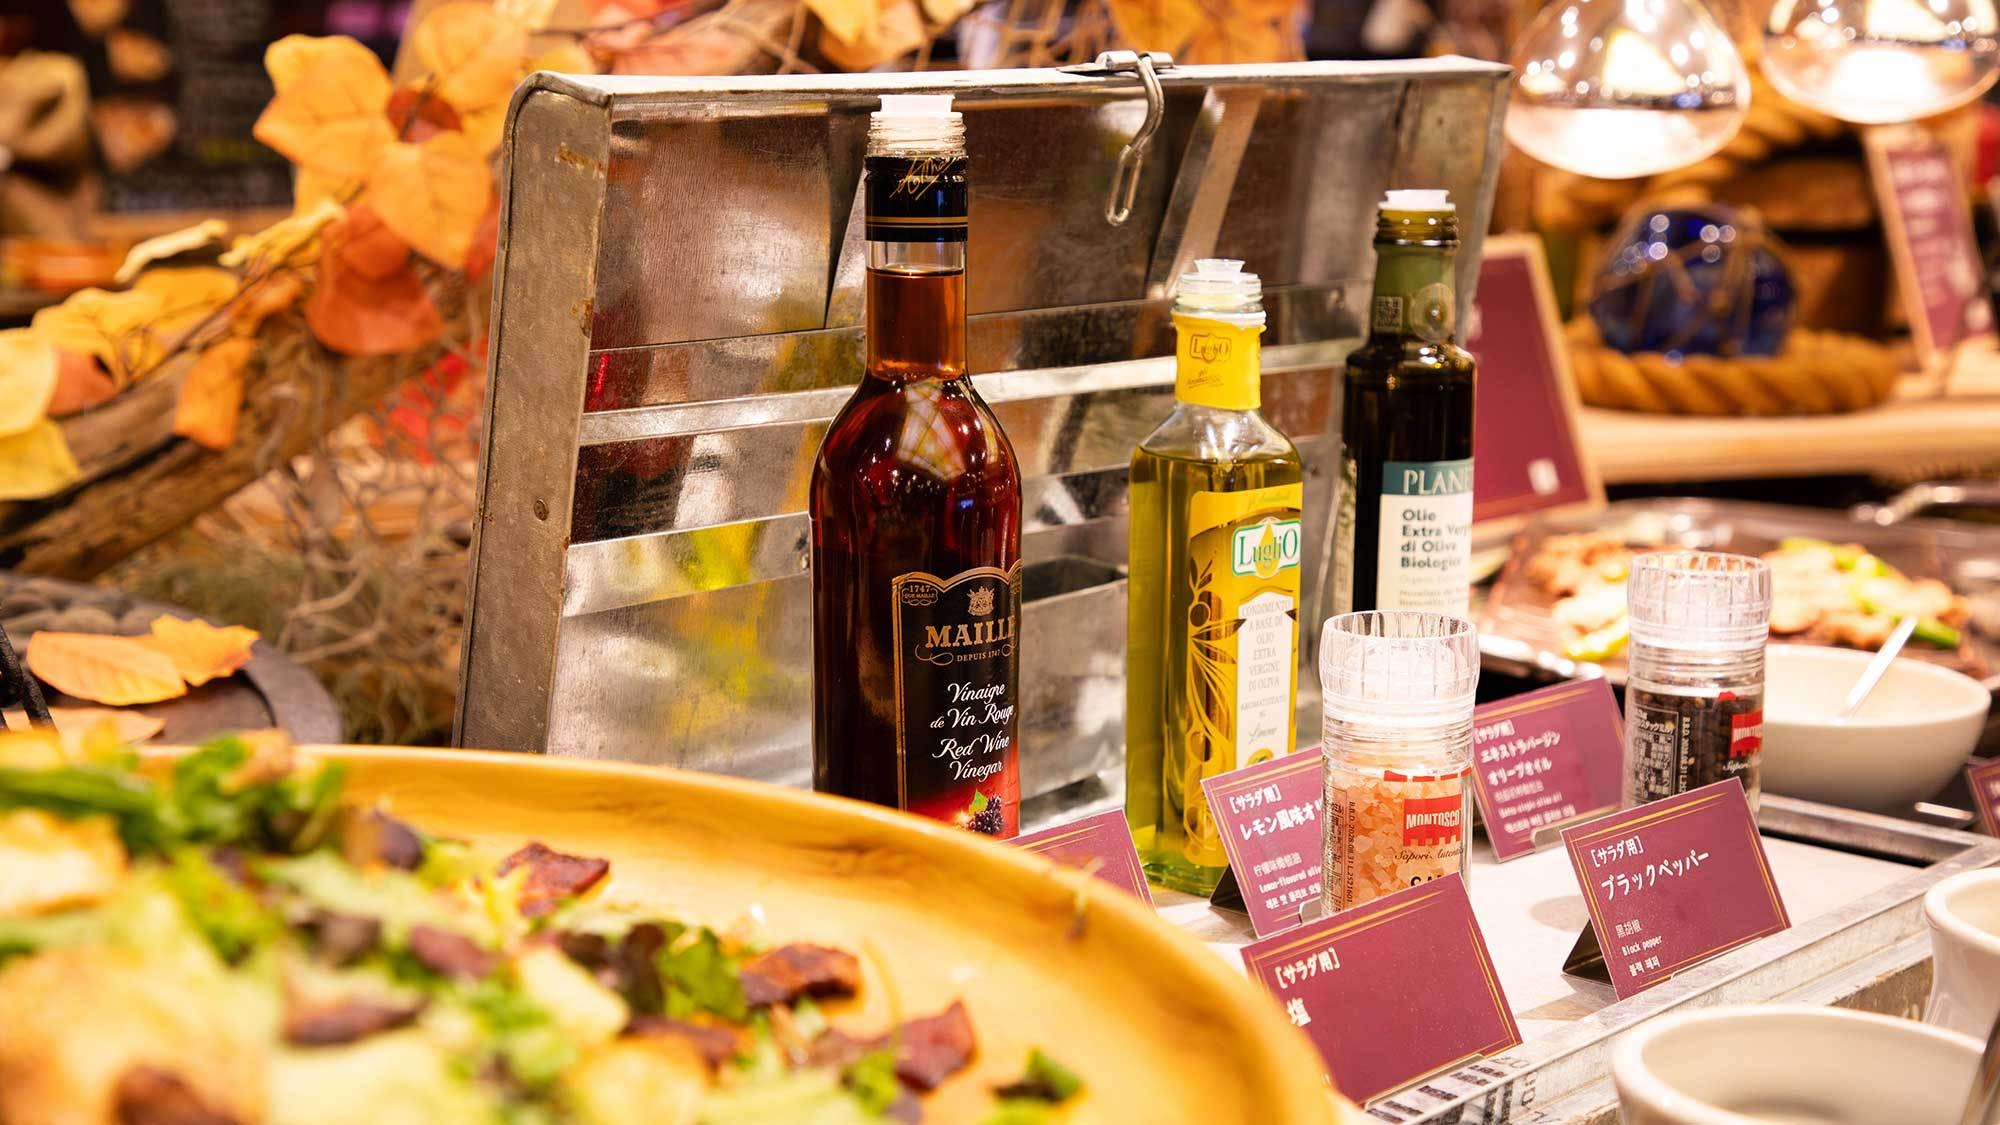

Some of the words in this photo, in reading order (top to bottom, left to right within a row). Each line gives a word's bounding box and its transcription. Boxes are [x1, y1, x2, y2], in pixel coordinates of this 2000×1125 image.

[909, 585, 931, 593] 1747
[957, 653, 986, 662] DEPUIS
[988, 649, 1001, 659] 1747
[947, 681, 1006, 704] Vinaigre
[930, 716, 945, 728] de
[947, 707, 977, 728] Vin
[978, 703, 1015, 725] Rouge
[932, 738, 980, 760] Red
[980, 730, 1010, 754] Wine
[949, 759, 1004, 782] Vinegar
[1406, 808, 1462, 831] MONTOSCO
[1394, 849, 1432, 864] Sapori
[1601, 849, 1709, 901] ブラックペッパー
[1622, 942, 1641, 957] Black
[1642, 934, 1663, 951] pepper
